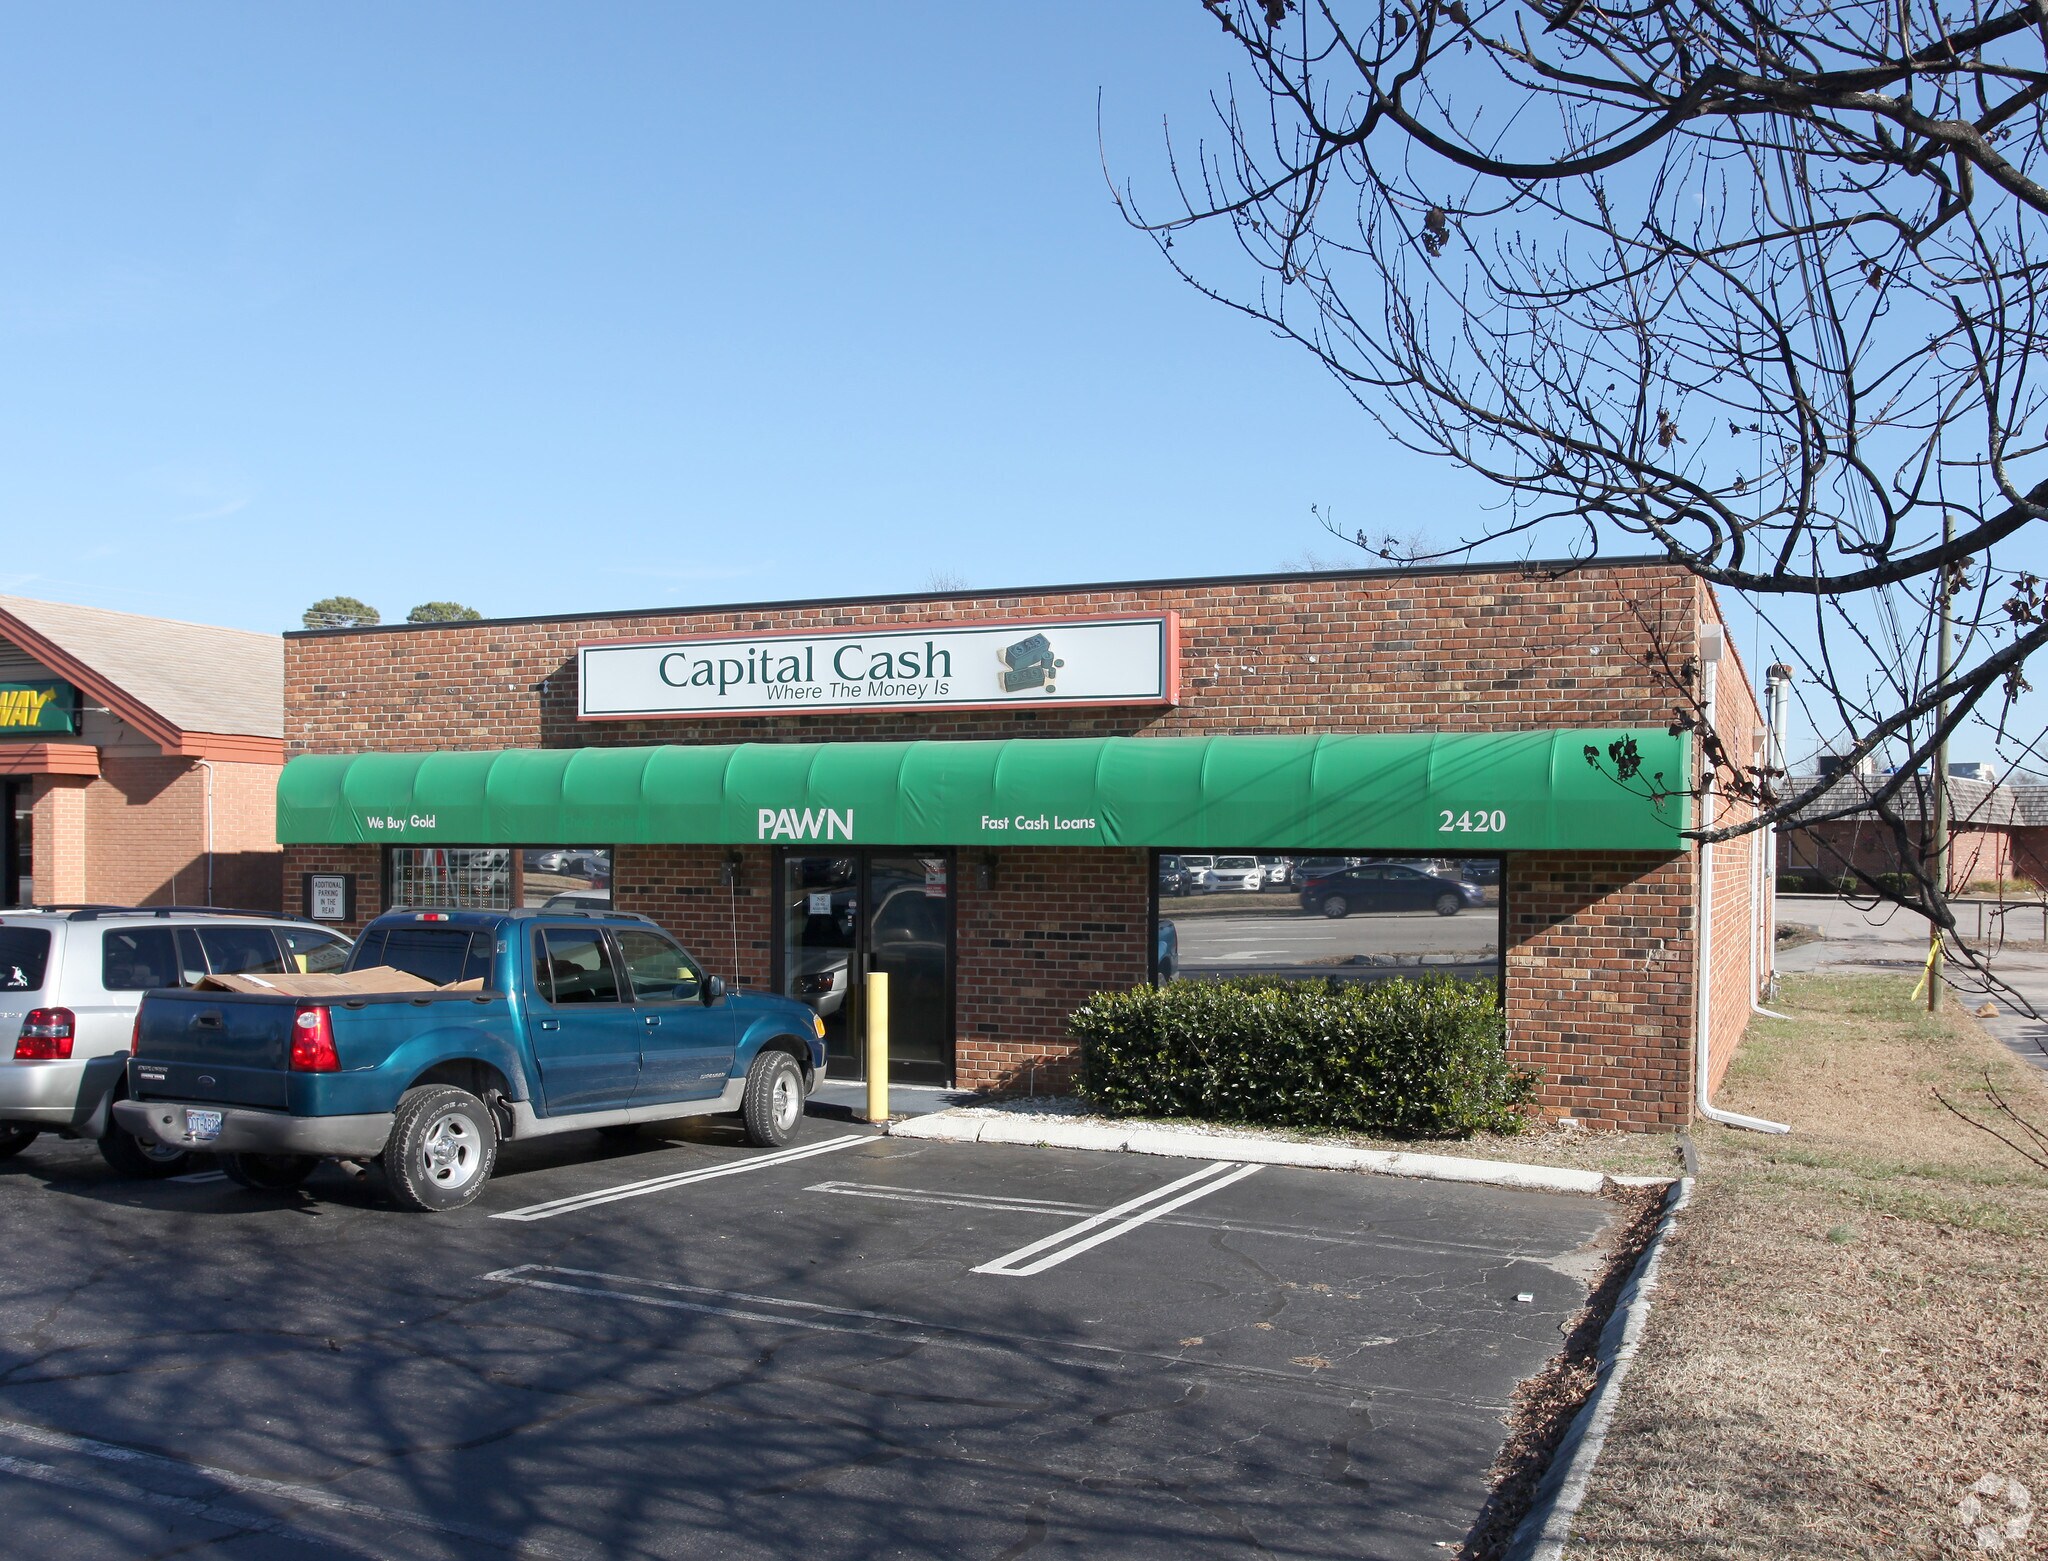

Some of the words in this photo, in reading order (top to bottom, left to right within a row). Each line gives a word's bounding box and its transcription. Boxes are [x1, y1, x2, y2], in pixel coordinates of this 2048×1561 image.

[659, 645, 815, 696] Capital
[833, 641, 953, 682] Cash
[766, 684, 823, 700] Where
[829, 681, 862, 698] The
[867, 680, 928, 700] Money
[934, 679, 949, 696] Is
[366, 816, 385, 829] We
[387, 816, 407, 832] Buy
[410, 814, 436, 829] Gold
[758, 807, 854, 840] PAWN
[981, 815, 1010, 830] Fast
[1014, 814, 1050, 830] Cash
[1054, 815, 1096, 830] Loans
[1438, 809, 1506, 832] 2420
[314, 881, 342, 889] ADDITIONAL
[318, 889, 339, 897] PARKING
[321, 906, 335, 914] REAR
[327, 898, 336, 906] THE
